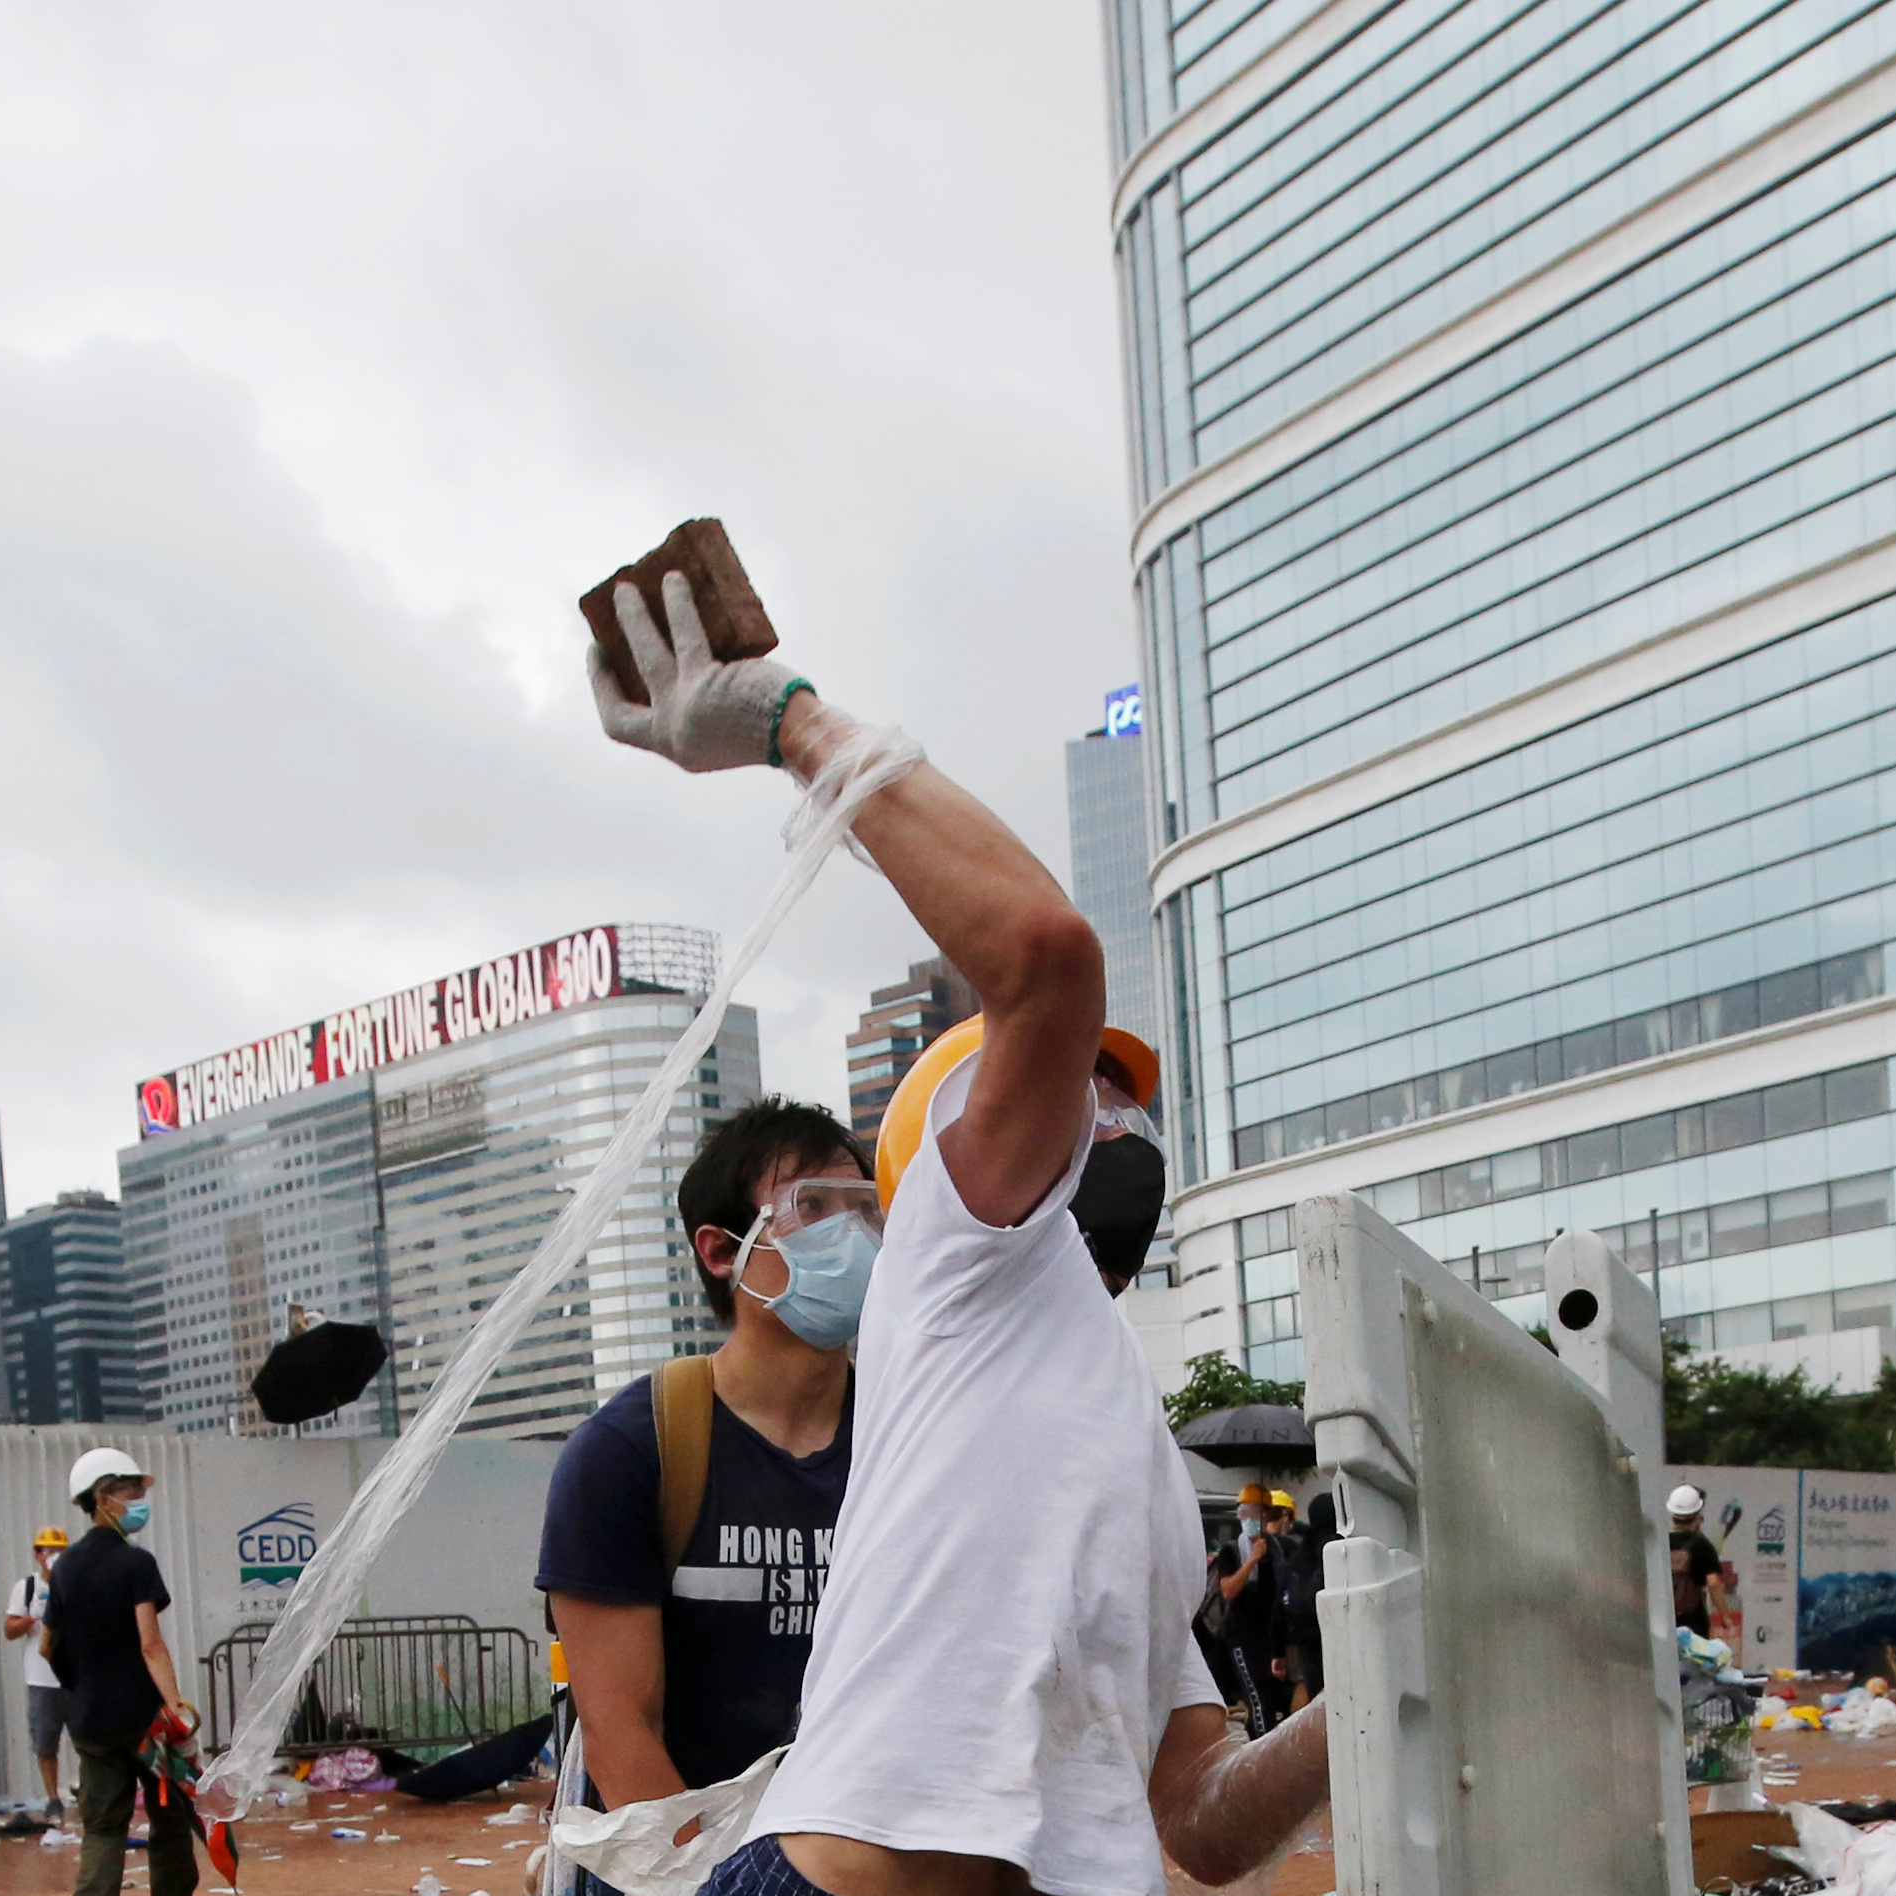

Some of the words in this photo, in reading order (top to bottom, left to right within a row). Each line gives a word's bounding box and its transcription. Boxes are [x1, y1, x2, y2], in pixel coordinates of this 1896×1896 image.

[176, 1025, 316, 1128] EVERGRANDE
[323, 979, 440, 1082] FORTUNE
[444, 945, 553, 1042] GLOBAL
[555, 926, 612, 1008] 500
[238, 1534, 317, 1563] CEDD
[719, 1525, 803, 1566] HONG
[814, 1528, 834, 1566] K
[761, 1568, 792, 1603] IS
[804, 1568, 828, 1603] N
[769, 1605, 814, 1635] CHI
